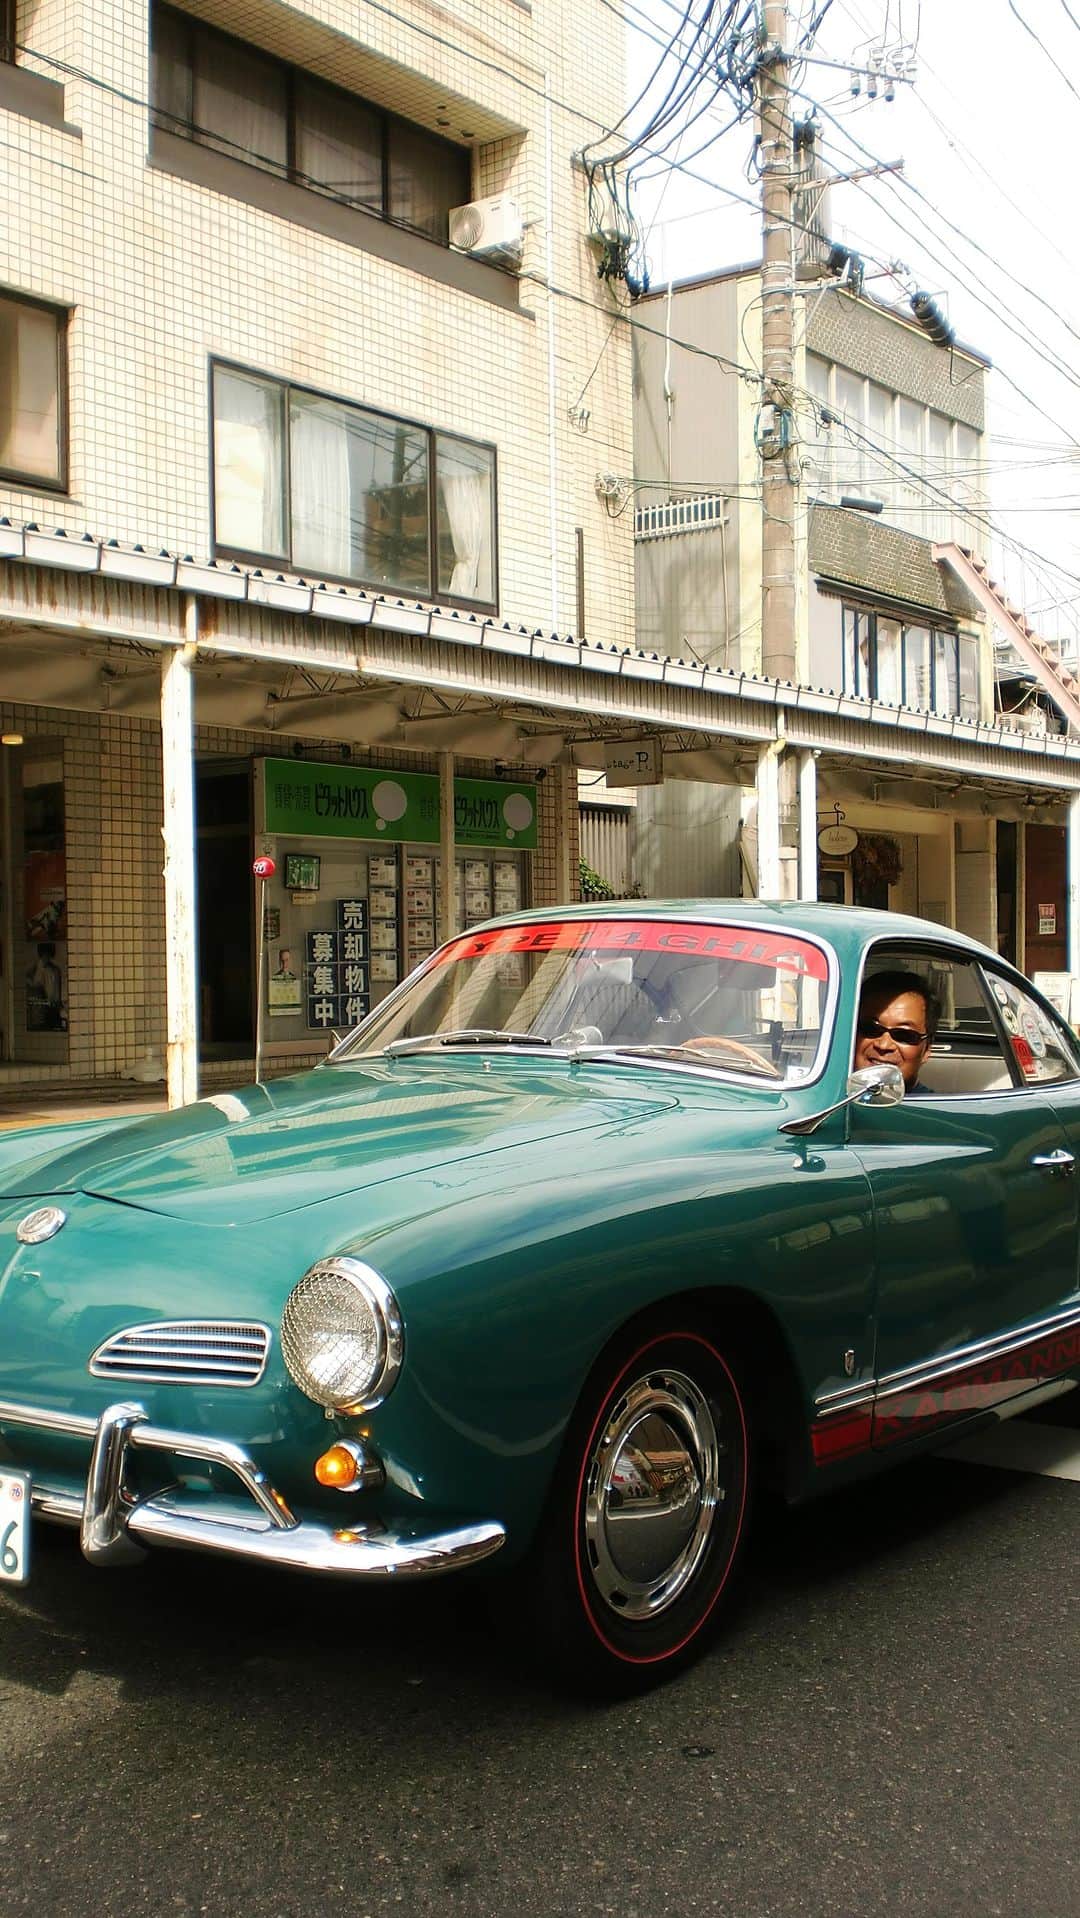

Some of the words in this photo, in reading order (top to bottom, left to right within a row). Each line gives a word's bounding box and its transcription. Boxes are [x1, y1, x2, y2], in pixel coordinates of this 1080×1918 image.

[314, 782, 369, 819] ピタットハウス
[343, 901, 366, 1027] 売却物件
[657, 932, 810, 972] GHIA
[312, 933, 335, 1027] 募集中
[0, 1520, 19, 1575] 6
